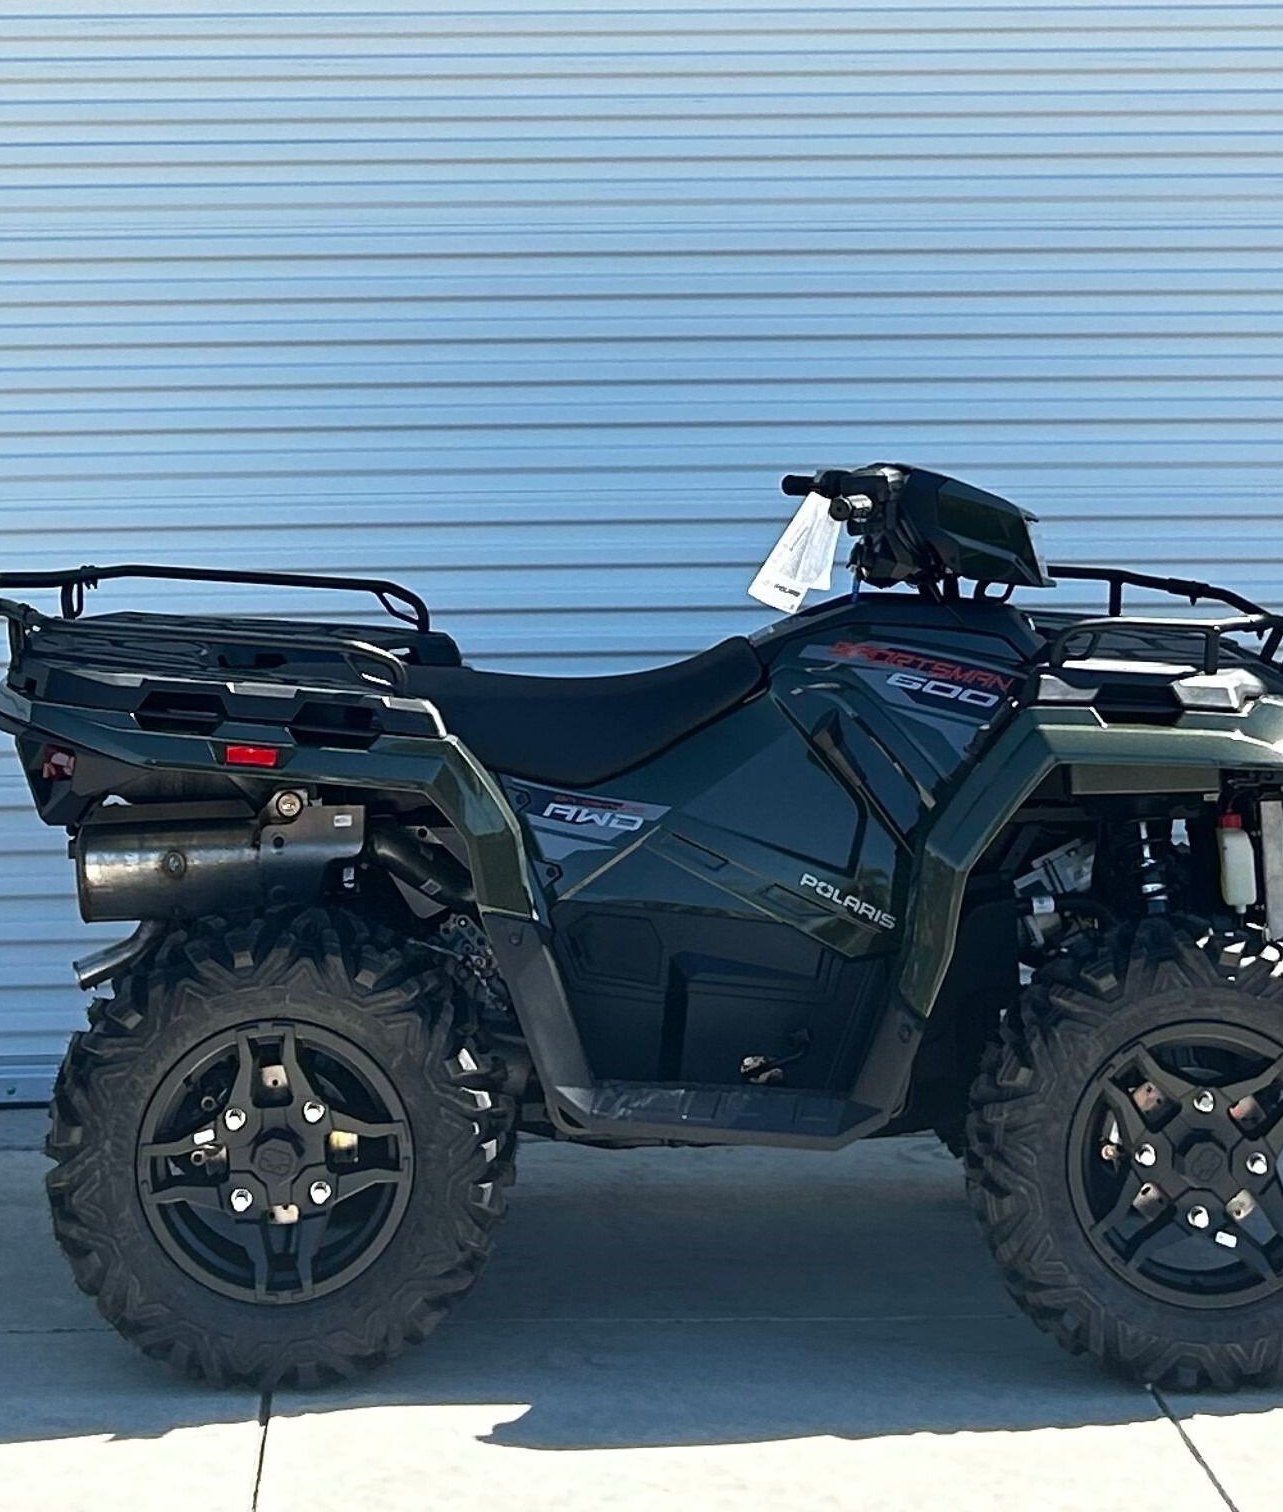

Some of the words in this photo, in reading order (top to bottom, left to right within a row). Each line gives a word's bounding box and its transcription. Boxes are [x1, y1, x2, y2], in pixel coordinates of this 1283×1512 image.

[828, 641, 1016, 691] SPORTSMAN
[886, 672, 1000, 708] 600
[542, 802, 645, 832] AWD
[799, 872, 897, 930] POLARIS
